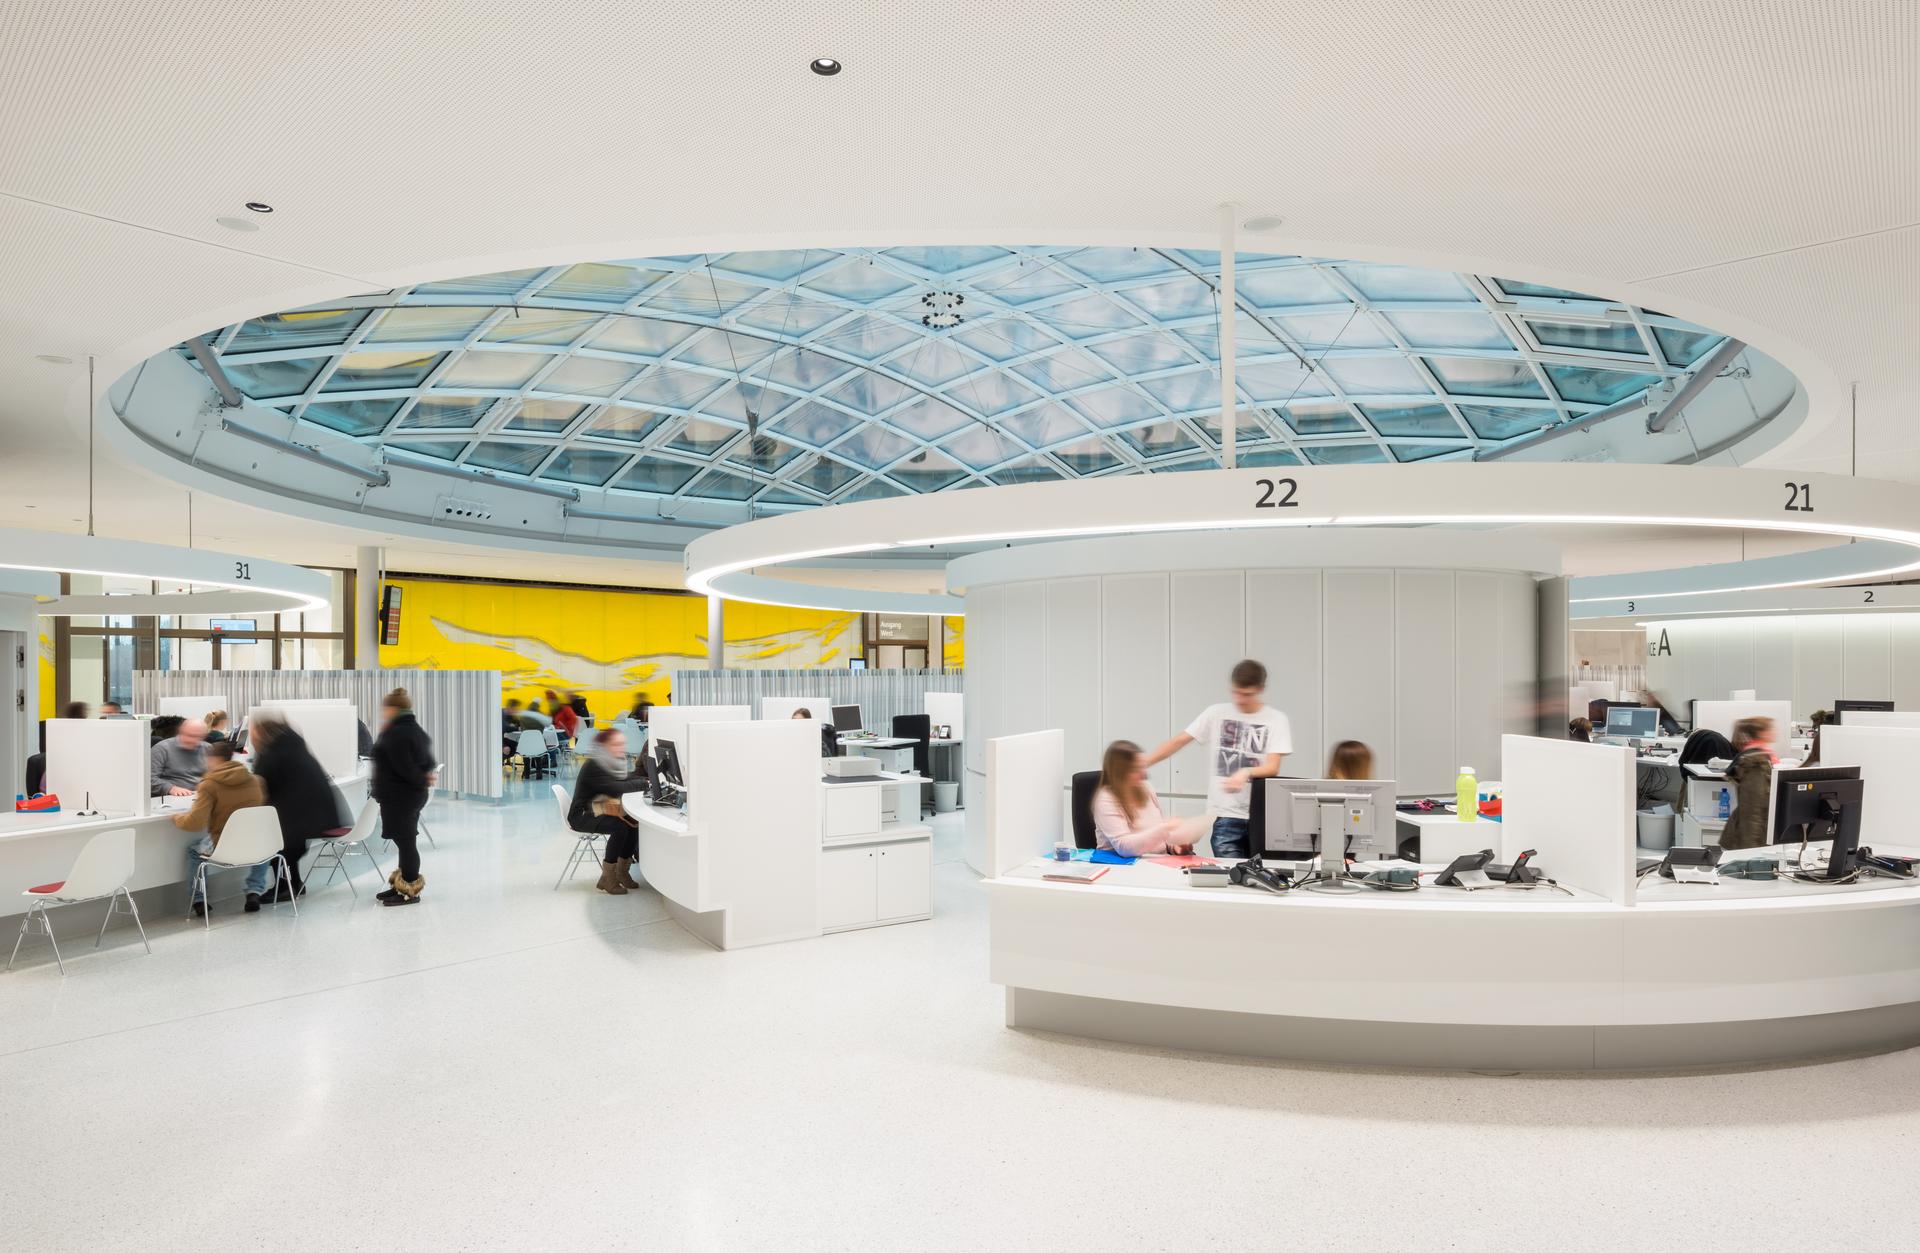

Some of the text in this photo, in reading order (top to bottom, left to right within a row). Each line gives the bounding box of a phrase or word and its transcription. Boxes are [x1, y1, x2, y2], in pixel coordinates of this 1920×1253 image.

[1255, 478, 1298, 508] 22
[1784, 482, 1815, 513] 21
[234, 561, 251, 580] 31
[1627, 601, 1636, 613] 3
[1863, 590, 1875, 603] 2
[1657, 628, 1672, 656] A
